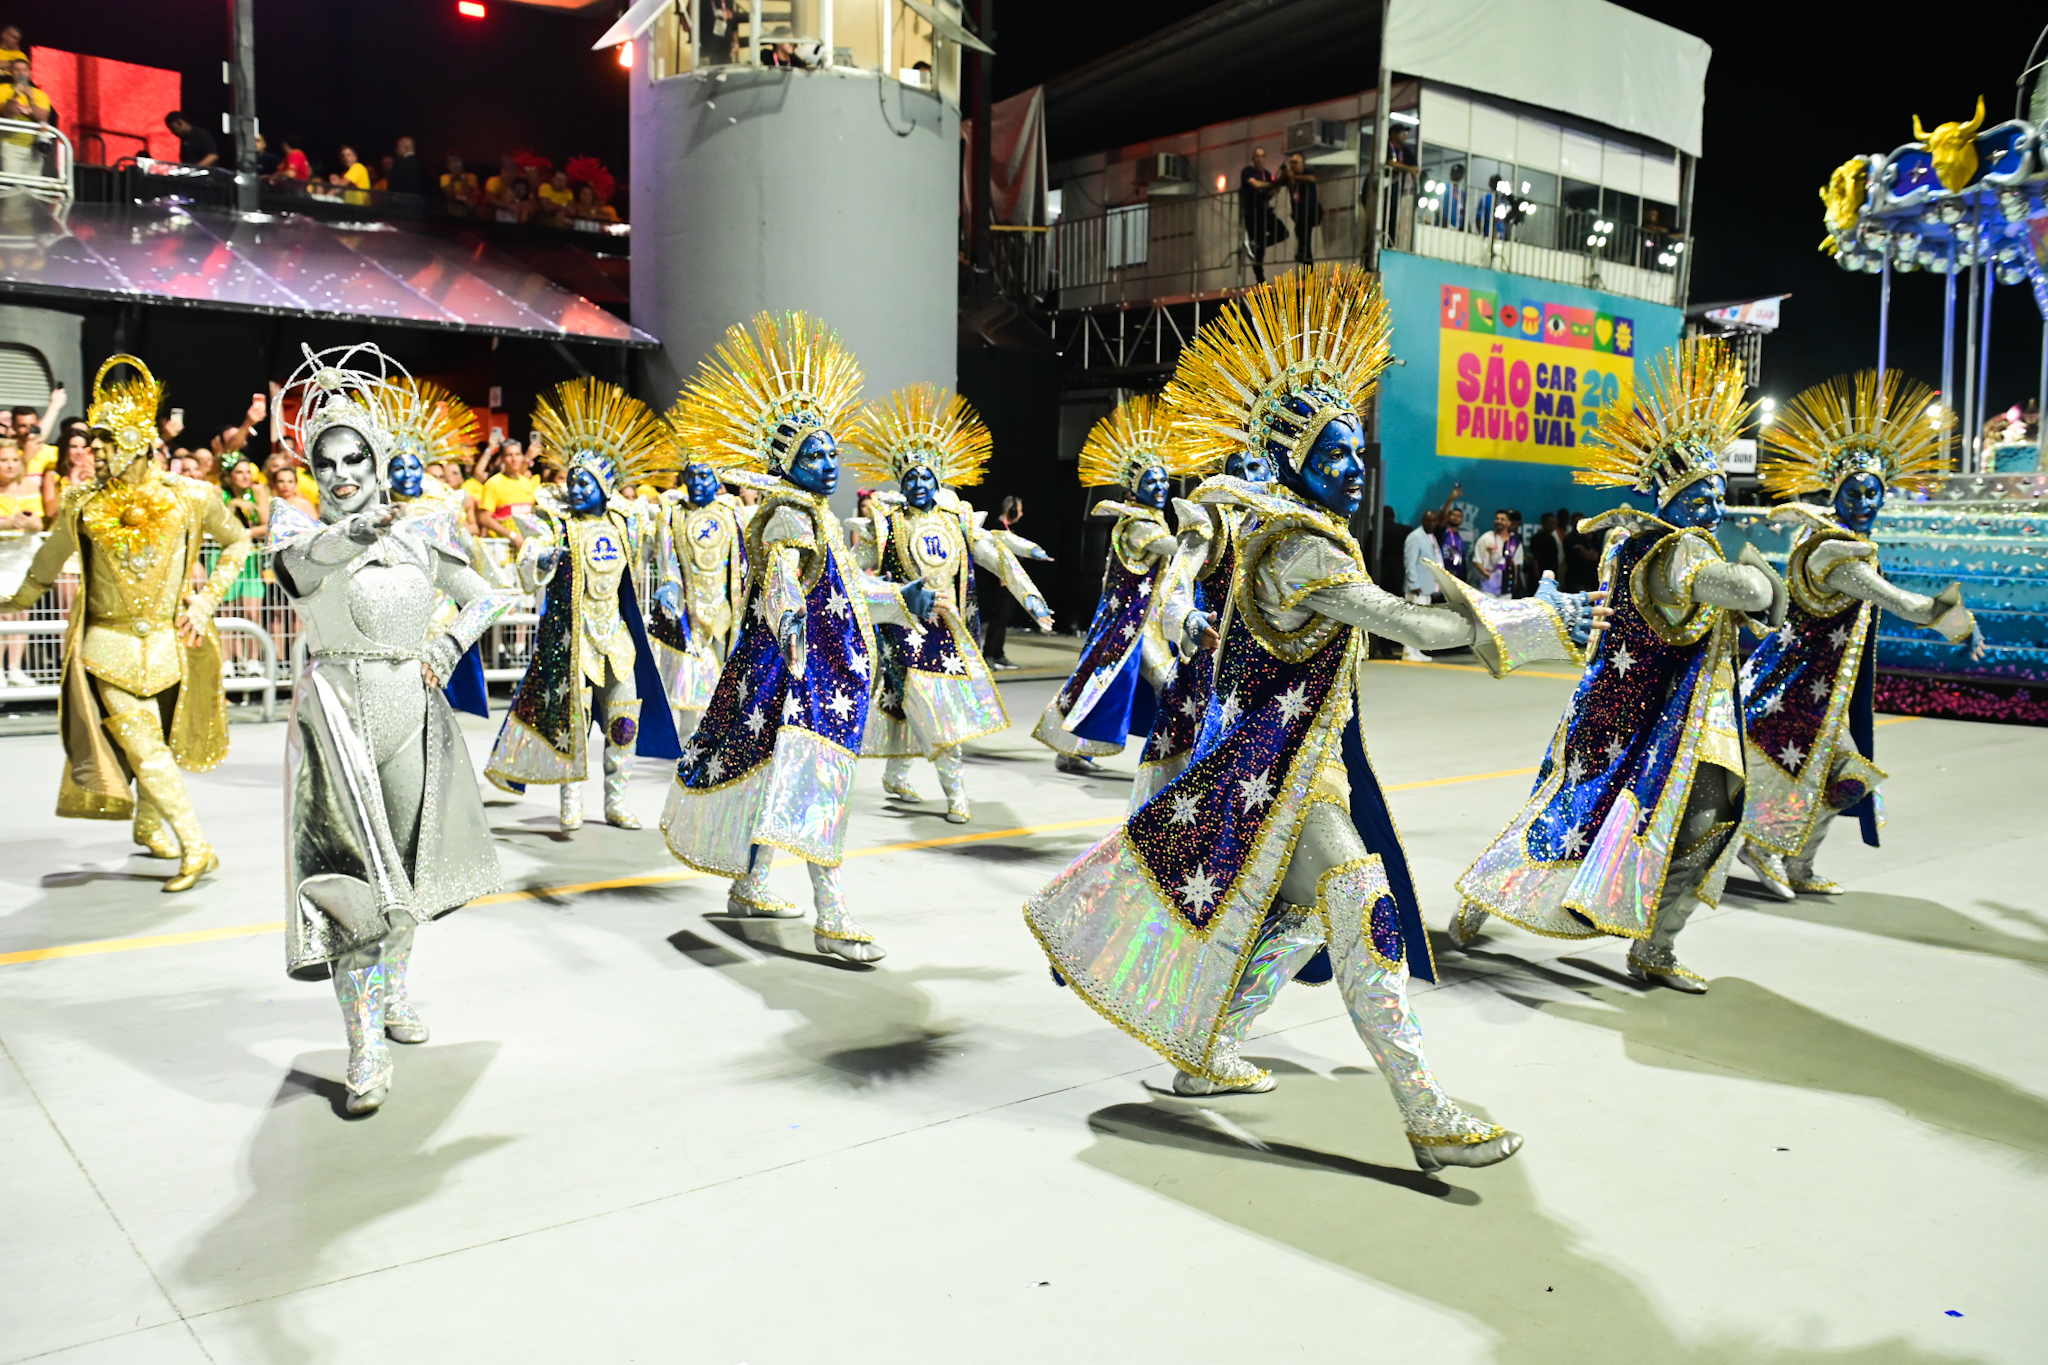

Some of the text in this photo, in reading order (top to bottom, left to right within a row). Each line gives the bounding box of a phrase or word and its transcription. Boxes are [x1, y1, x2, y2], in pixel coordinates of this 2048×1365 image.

[1457, 343, 1531, 408] SÃO
[1536, 362, 1577, 392] CAR
[1582, 369, 1619, 408] 20
[1535, 392, 1576, 419] NA
[1456, 404, 1529, 442] PAULO
[1534, 418, 1575, 447] VAL
